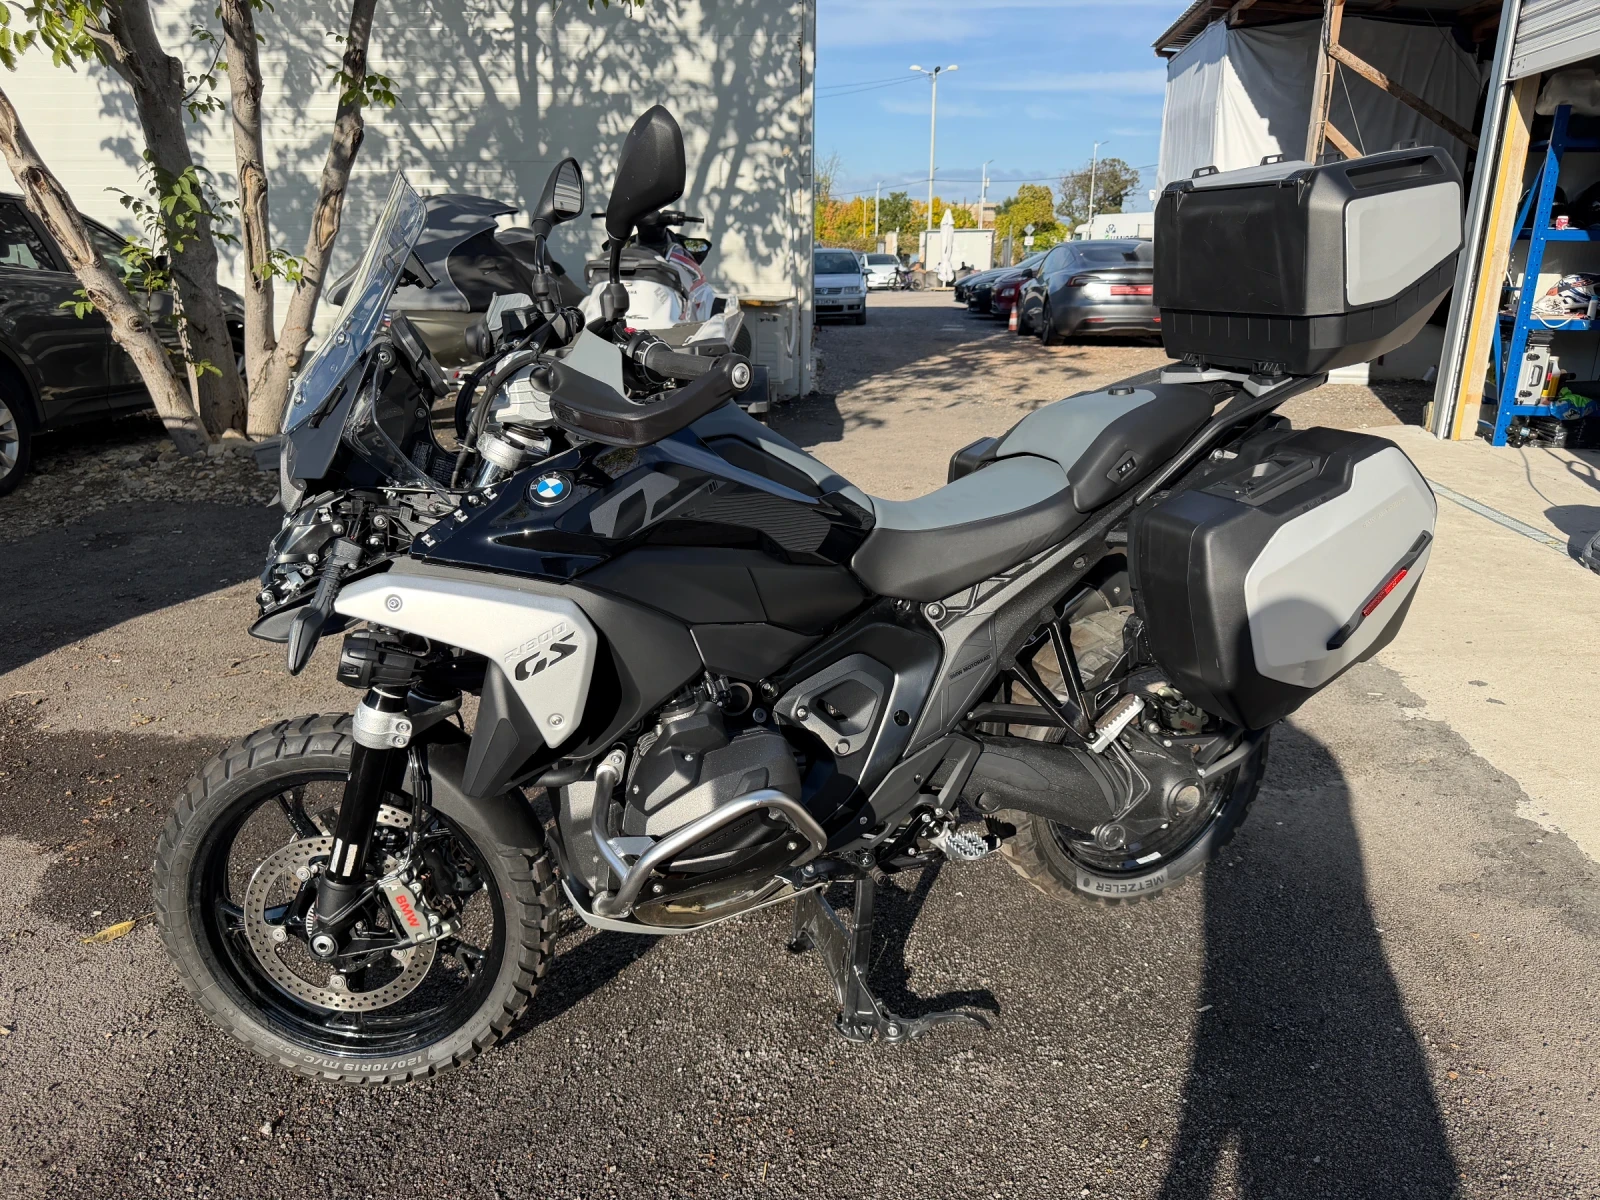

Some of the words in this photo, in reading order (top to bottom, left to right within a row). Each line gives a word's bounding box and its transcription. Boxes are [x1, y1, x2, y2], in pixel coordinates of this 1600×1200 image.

[504, 622, 567, 664] R1300
[514, 629, 578, 682] GS
[962, 654, 991, 673] MOTORRAD
[1095, 875, 1165, 893] METZELER
[395, 894, 420, 927] BMW
[303, 1057, 340, 1071] M/C
[343, 1055, 422, 1072] 120/70R19
